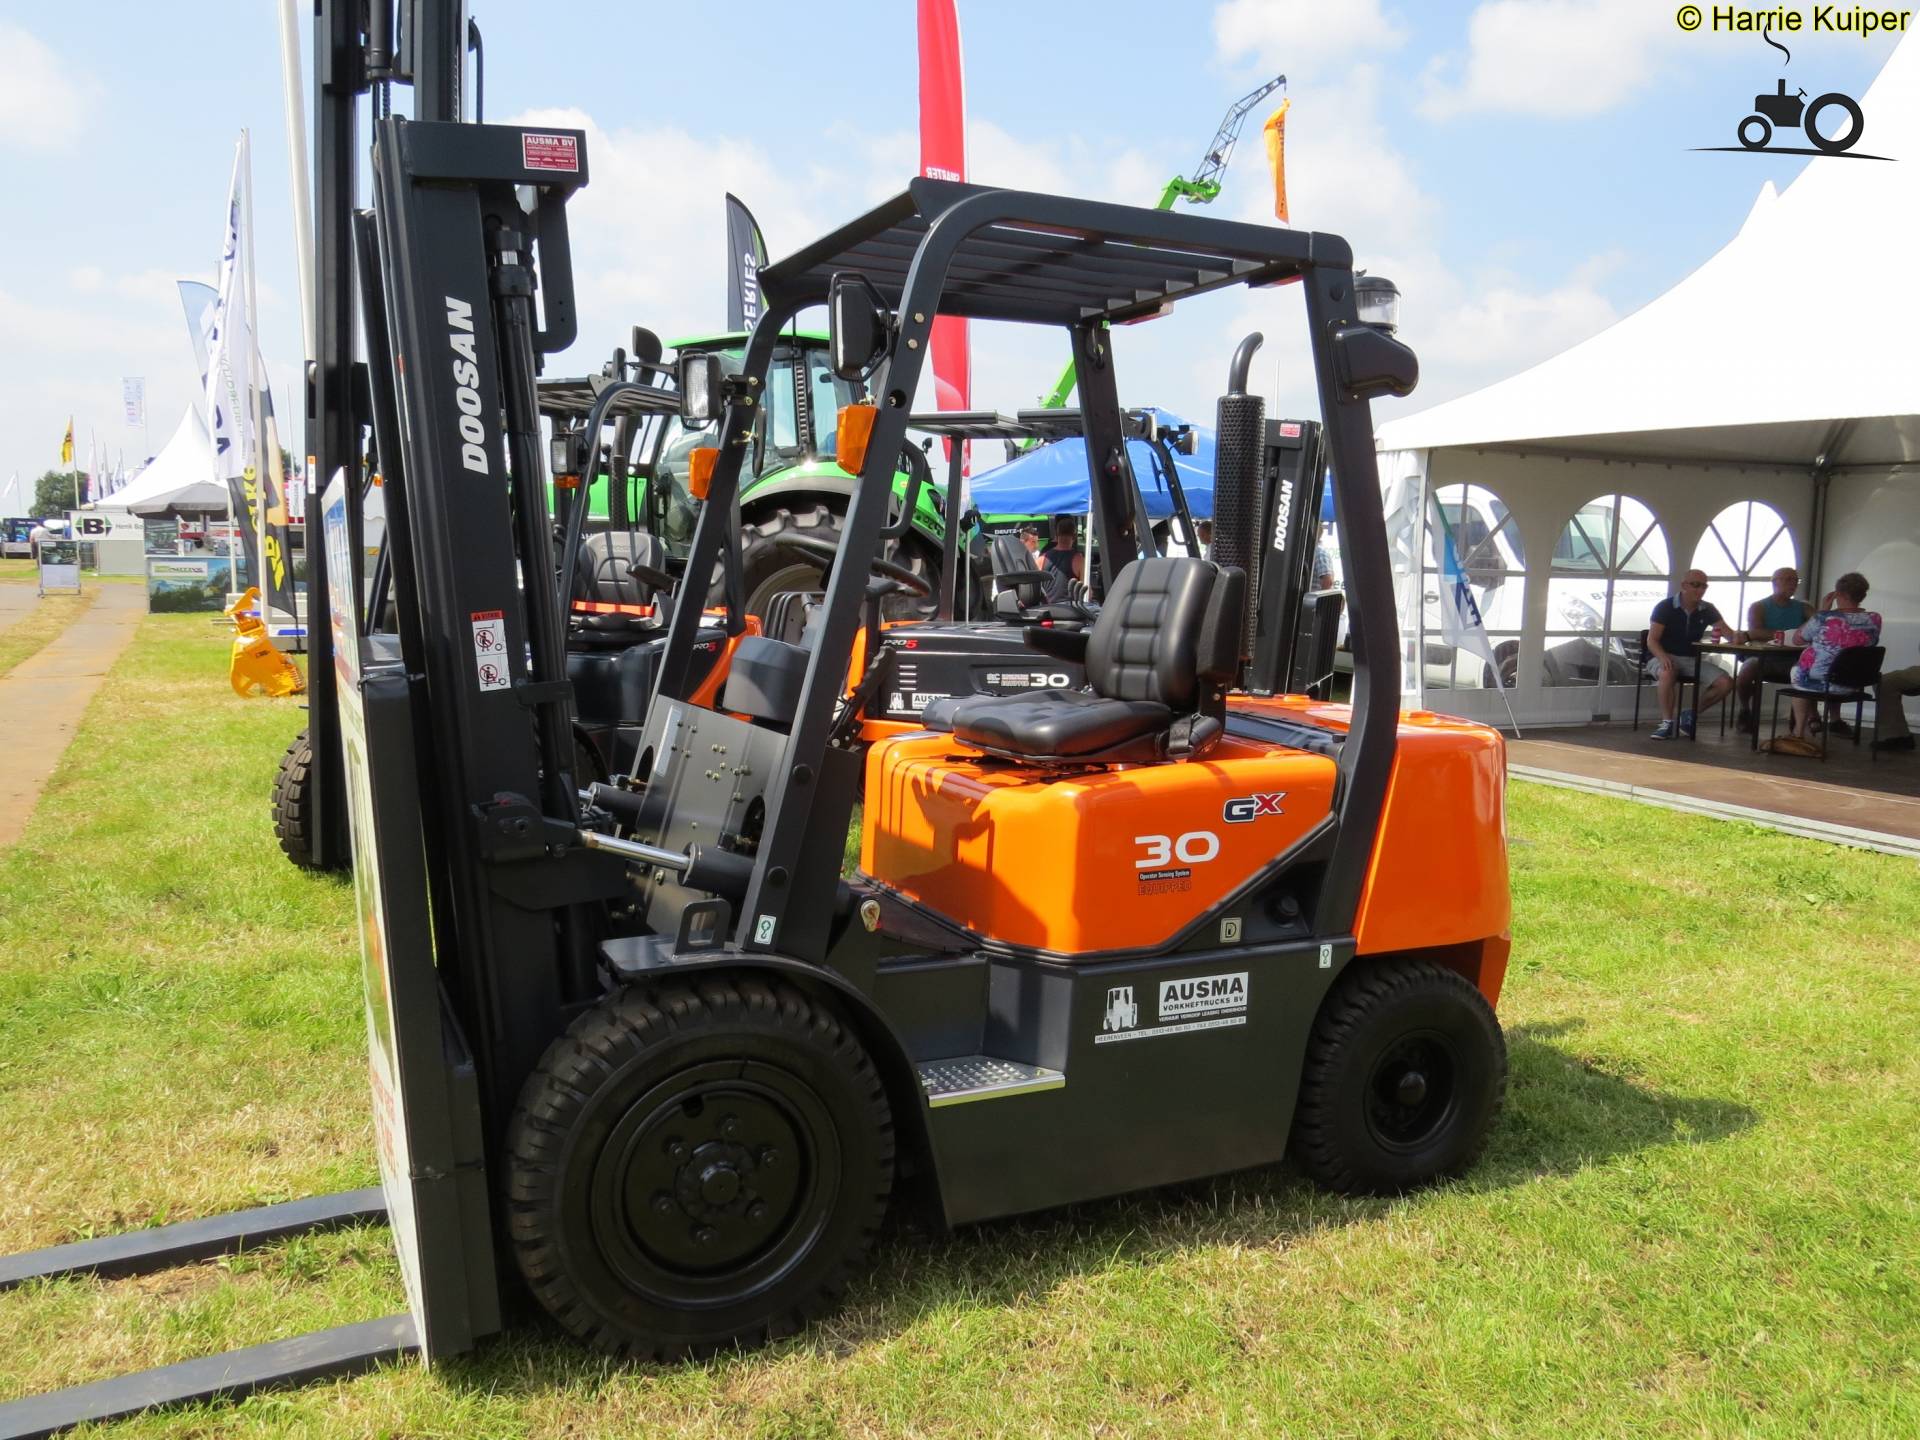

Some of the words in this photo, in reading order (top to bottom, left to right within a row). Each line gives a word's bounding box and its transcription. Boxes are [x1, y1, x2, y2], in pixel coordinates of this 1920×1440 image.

[527, 137, 560, 146] AUSMA
[445, 296, 489, 475] DOOSAN
[1273, 479, 1293, 551] DOOSAN
[83, 518, 104, 535] B
[883, 639, 918, 649] PRO5
[1030, 673, 1070, 687] 30
[913, 694, 943, 703] AUS
[1222, 792, 1288, 824] GX
[1135, 831, 1220, 869] 30
[1164, 977, 1244, 1002] AUSMA
[1163, 997, 1230, 1011] VORKHEFTRUCKS
[1233, 995, 1244, 1003] BV
